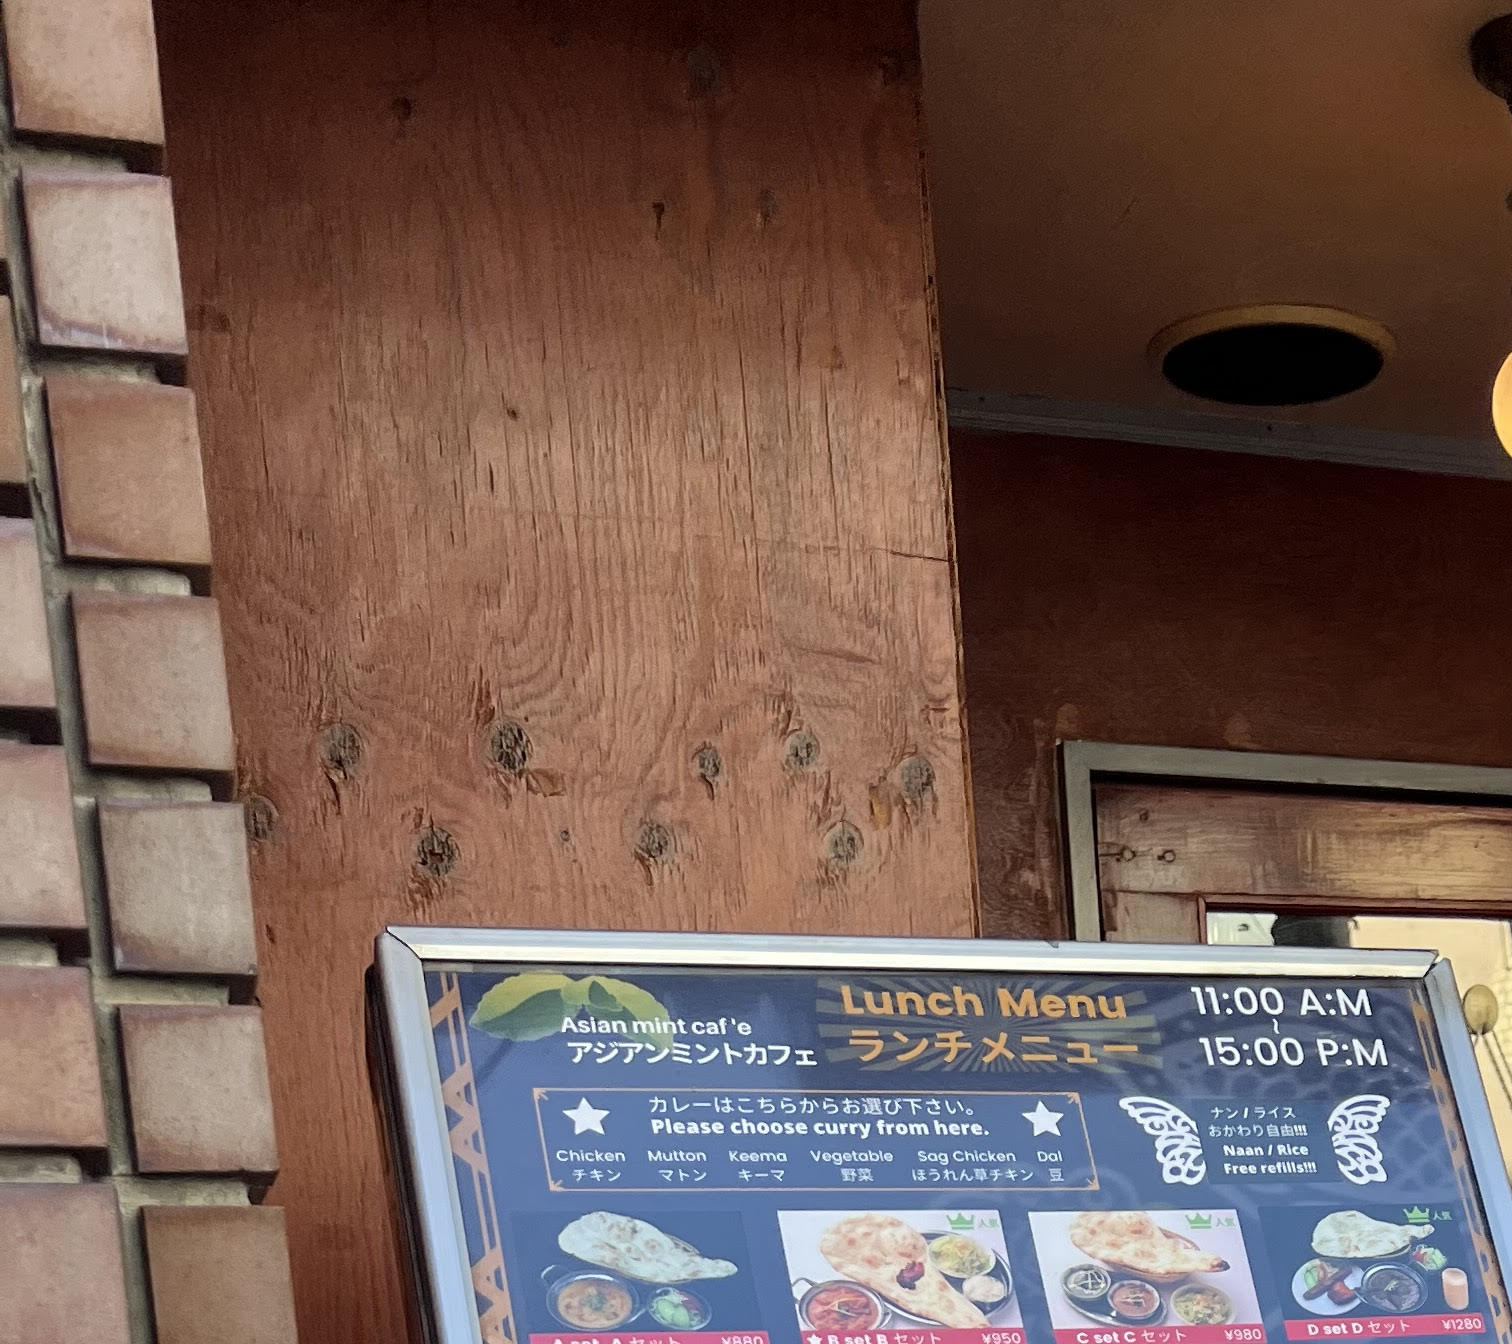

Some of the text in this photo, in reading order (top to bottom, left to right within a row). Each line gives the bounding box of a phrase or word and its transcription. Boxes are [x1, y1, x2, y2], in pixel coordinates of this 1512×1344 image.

[841, 985, 1127, 1020] Lunch Menu
[1191, 986, 1372, 1017] 11:00 A:M
[561, 1017, 628, 1034] Asian
[633, 1017, 687, 1034] mint
[568, 1042, 817, 1066] アジアンミントカフェ
[848, 1030, 1139, 1065] ランチメニュー
[1199, 1037, 1388, 1067] 15:00 P:M
[652, 1118, 989, 1139] Please choose curry from here.
[556, 1150, 1062, 1166] Chicken Mutton Keema Vegetable Sag Chicken Dal
[1224, 1161, 1317, 1175] Free refills!!!
[1225, 1328, 1262, 1341] ¥980
